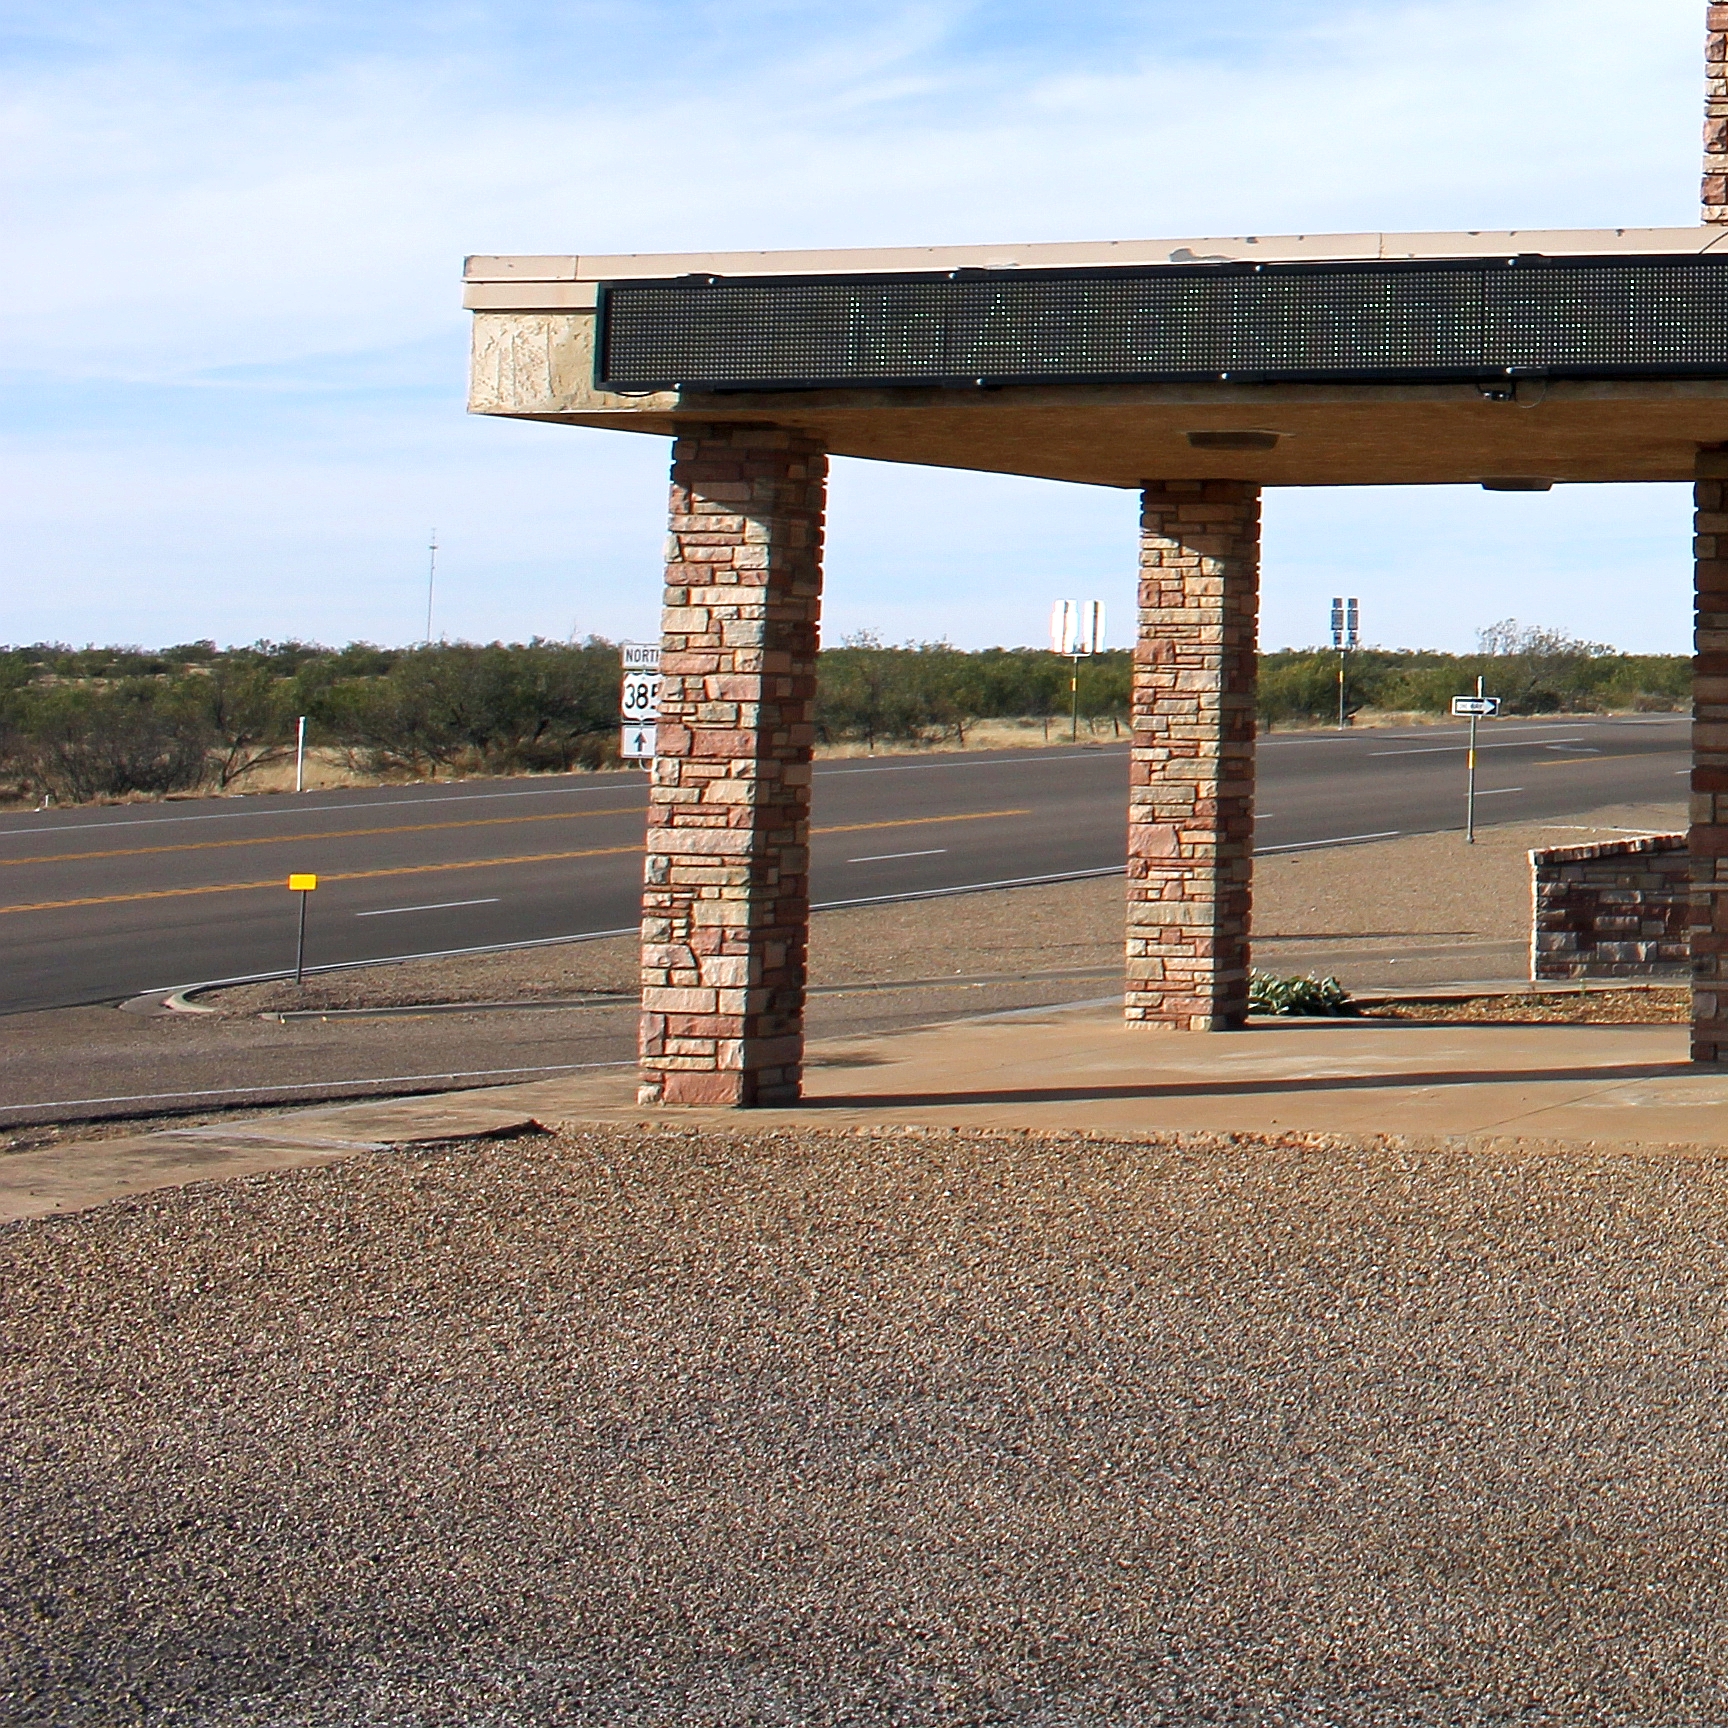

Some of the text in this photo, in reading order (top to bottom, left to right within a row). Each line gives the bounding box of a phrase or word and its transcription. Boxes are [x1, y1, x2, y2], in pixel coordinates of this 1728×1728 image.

[848, 294, 940, 367] No
[967, 290, 1099, 364] Act
[1127, 288, 1199, 360] of
